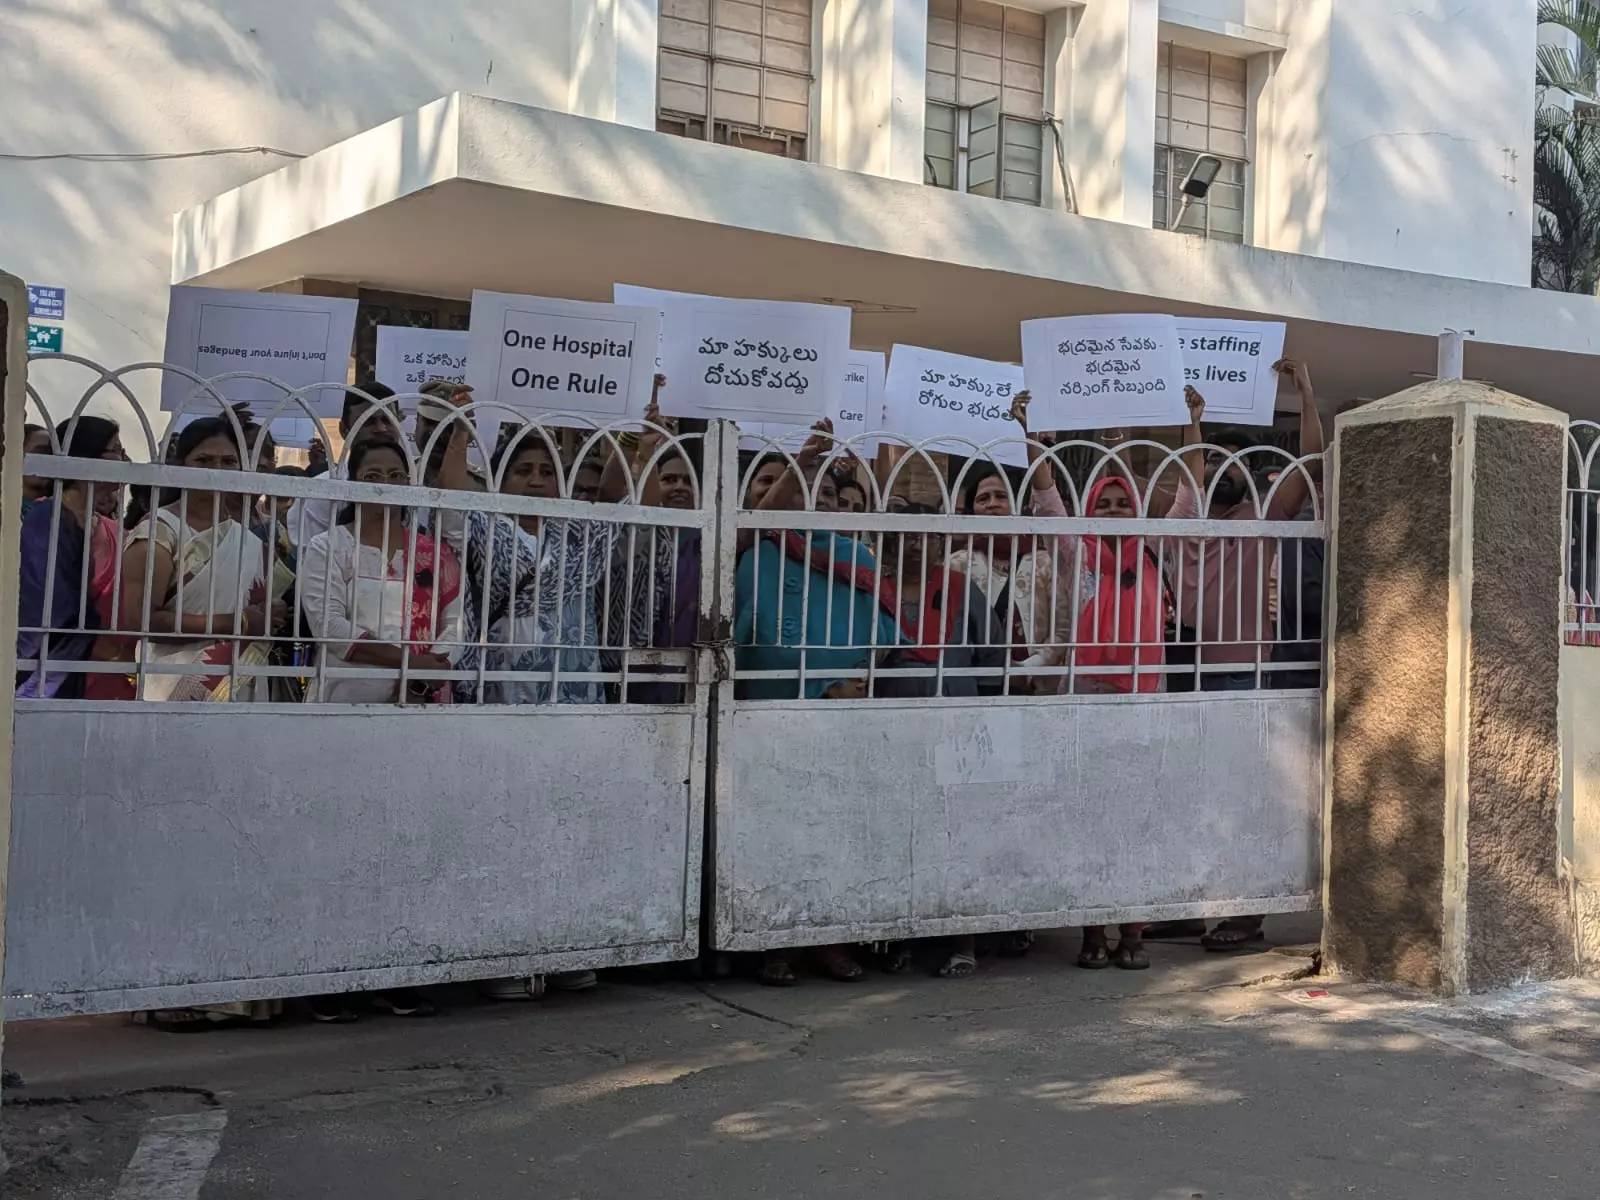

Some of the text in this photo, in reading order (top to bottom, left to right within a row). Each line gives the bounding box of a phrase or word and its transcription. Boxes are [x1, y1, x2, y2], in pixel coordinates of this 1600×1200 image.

[198, 345, 247, 358] Bandages
[250, 349, 271, 357] your
[504, 330, 633, 359] One Hospital
[698, 337, 818, 363] మా హక్కులు
[1058, 338, 1115, 356] భద్రమైన
[1117, 336, 1157, 351] సేవకు
[1190, 336, 1261, 356] staffing
[274, 350, 300, 360] injure
[403, 352, 424, 364] ఒక
[1085, 358, 1141, 375] భద్రమైన
[1205, 364, 1247, 382] lives
[512, 367, 618, 395] One Rule
[704, 363, 809, 394] దోచుకోవద్దు
[844, 372, 865, 383] rike
[920, 369, 1012, 397] మా హక్కులే
[1060, 378, 1166, 397] నర్సింగ్ సిబ్బంది
[919, 389, 963, 411] రోగుల
[840, 409, 864, 422] Care
